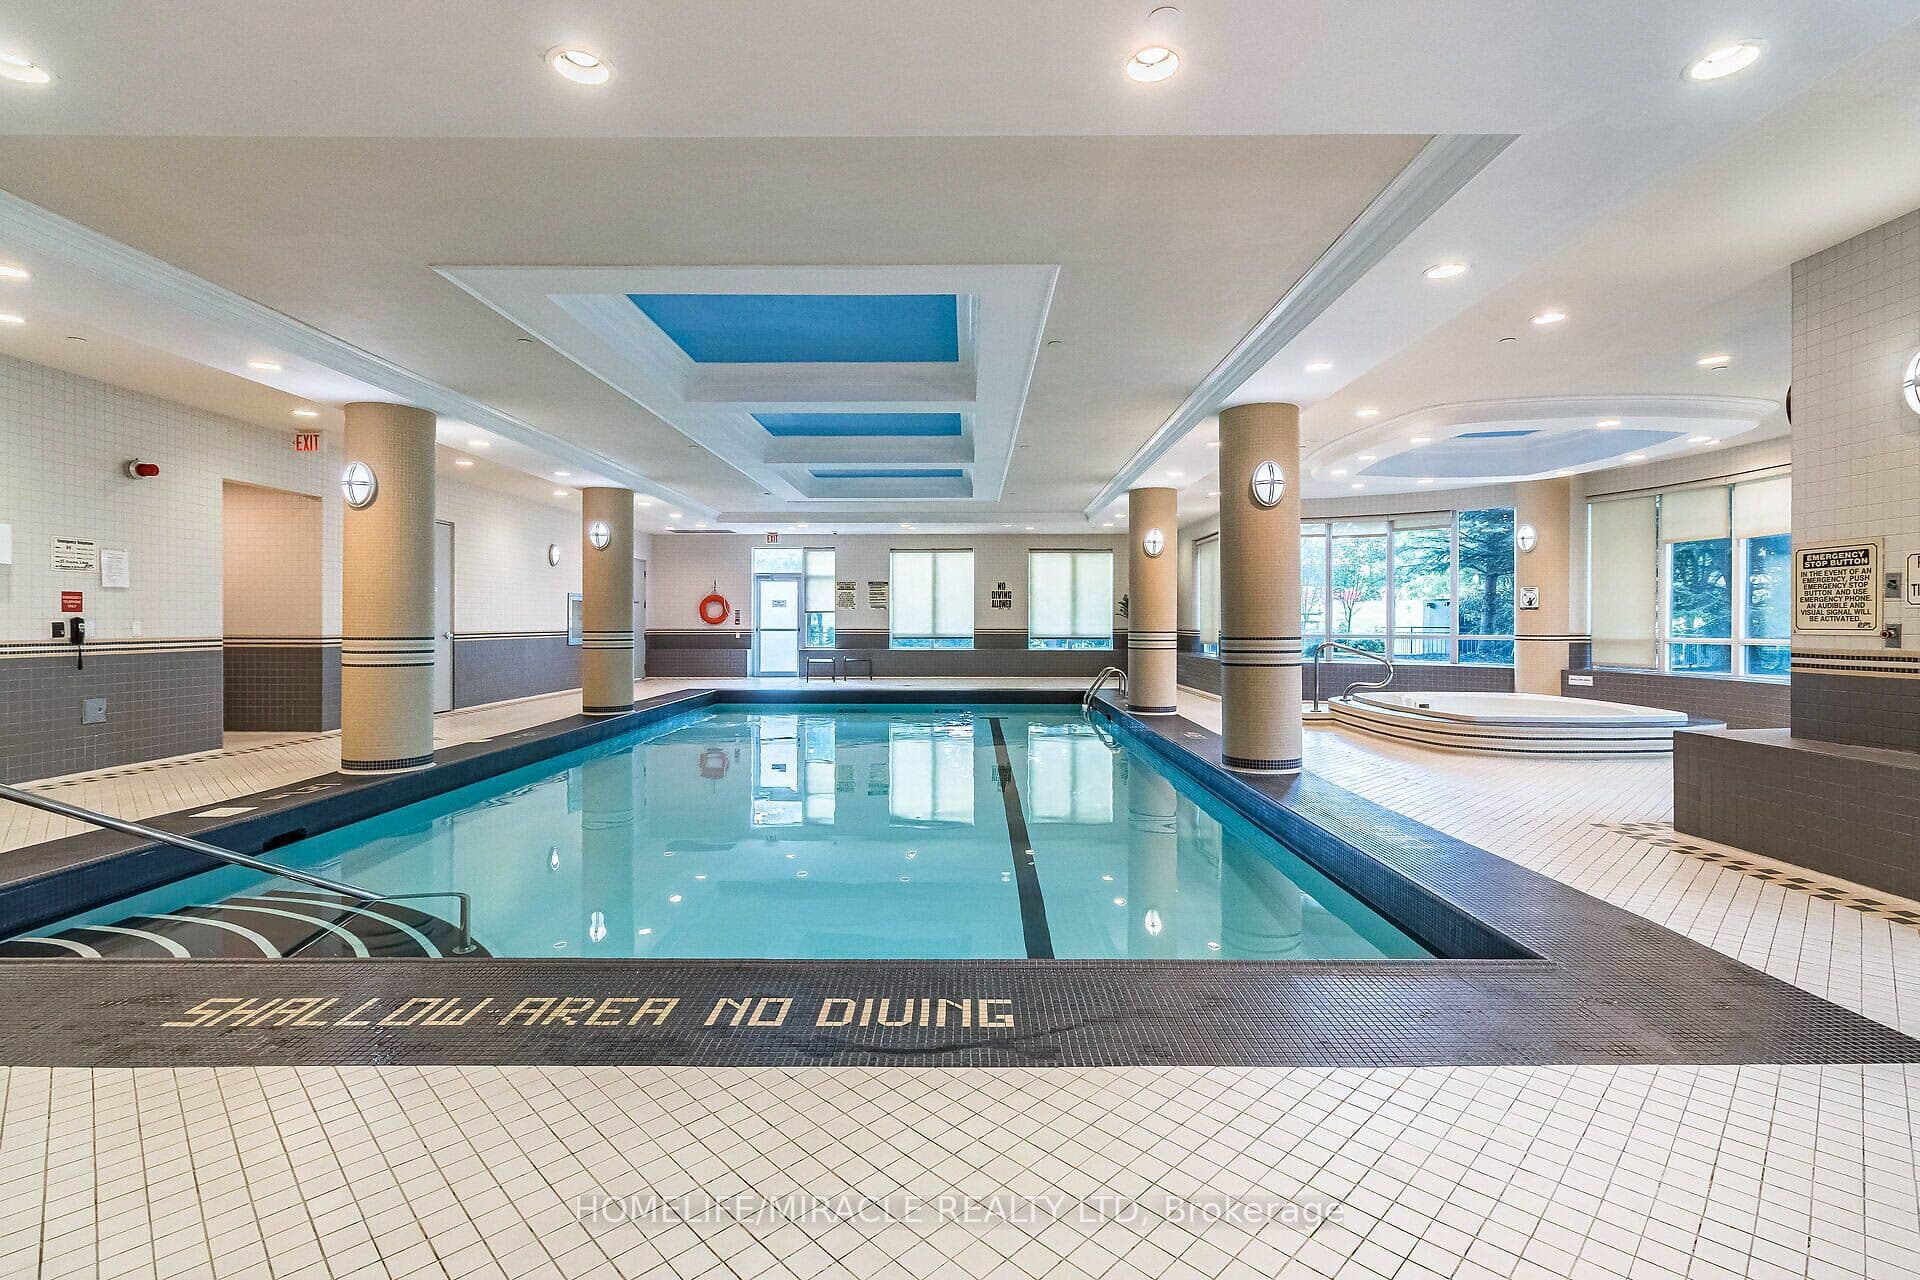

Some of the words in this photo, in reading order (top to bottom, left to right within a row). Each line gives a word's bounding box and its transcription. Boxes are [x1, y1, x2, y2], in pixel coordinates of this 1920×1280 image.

[296, 434, 320, 451] EXIT
[766, 534, 778, 543] EXIT
[1806, 550, 1865, 561] EMERGENCY
[1804, 560, 1828, 568] STOP
[1830, 557, 1868, 566] BUTTON
[997, 581, 1006, 590] NO
[1804, 582, 1846, 590] EMERGENCY
[991, 590, 1012, 599] DIVING
[1804, 589, 1832, 597] BUTTON
[1800, 595, 1843, 603] EMERGENCY
[1845, 594, 1872, 602] PHONE.
[160, 997, 494, 1027] SHALLOW
[498, 997, 681, 1027] AREA
[703, 997, 794, 1027] NO
